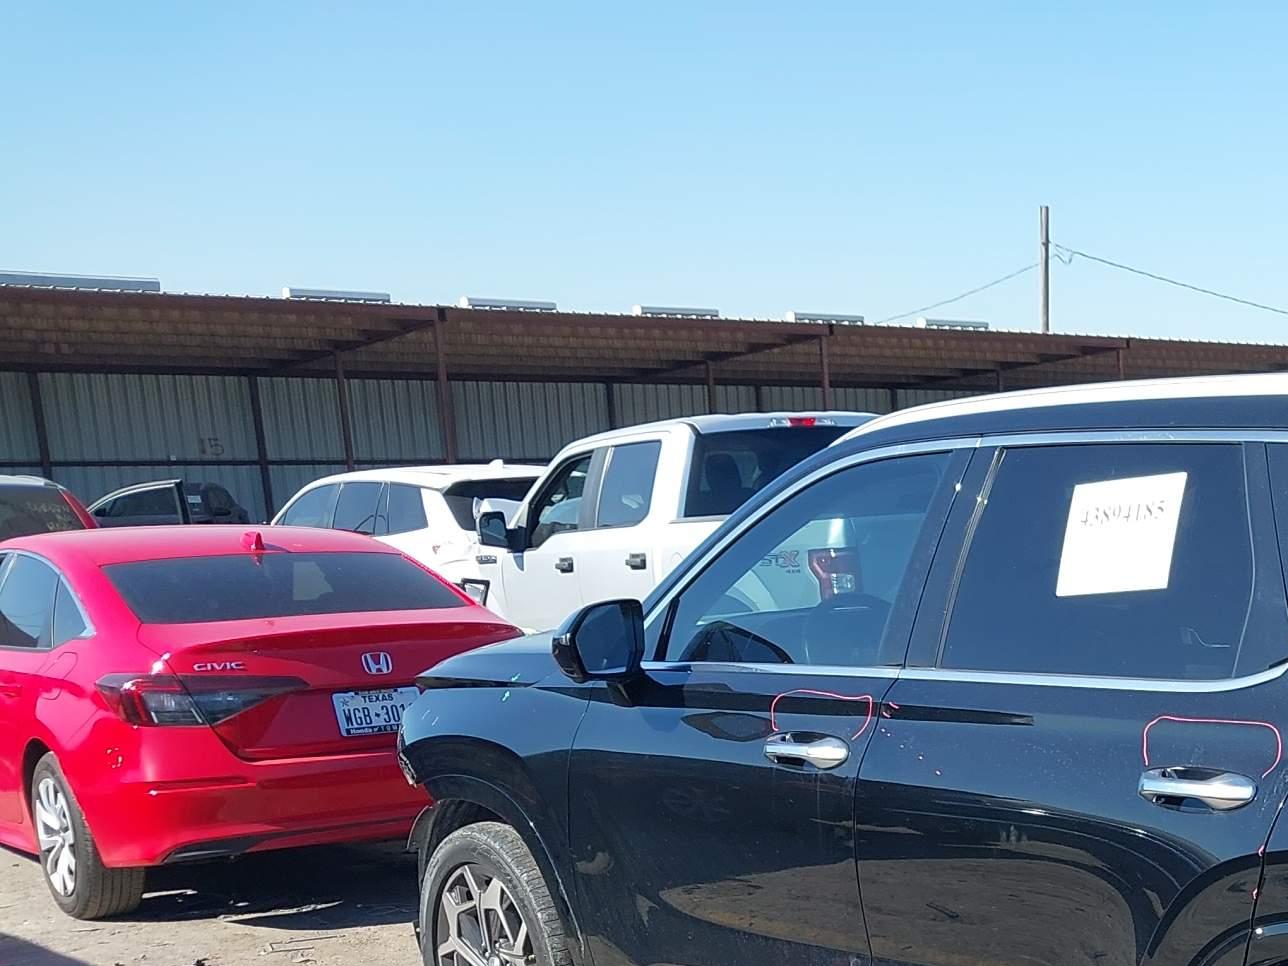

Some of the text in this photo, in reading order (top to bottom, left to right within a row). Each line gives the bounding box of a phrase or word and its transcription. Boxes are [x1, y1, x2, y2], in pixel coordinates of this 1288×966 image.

[193, 661, 246, 672] CIVIC
[361, 694, 394, 704] TEXAS
[350, 727, 373, 735] Honda
